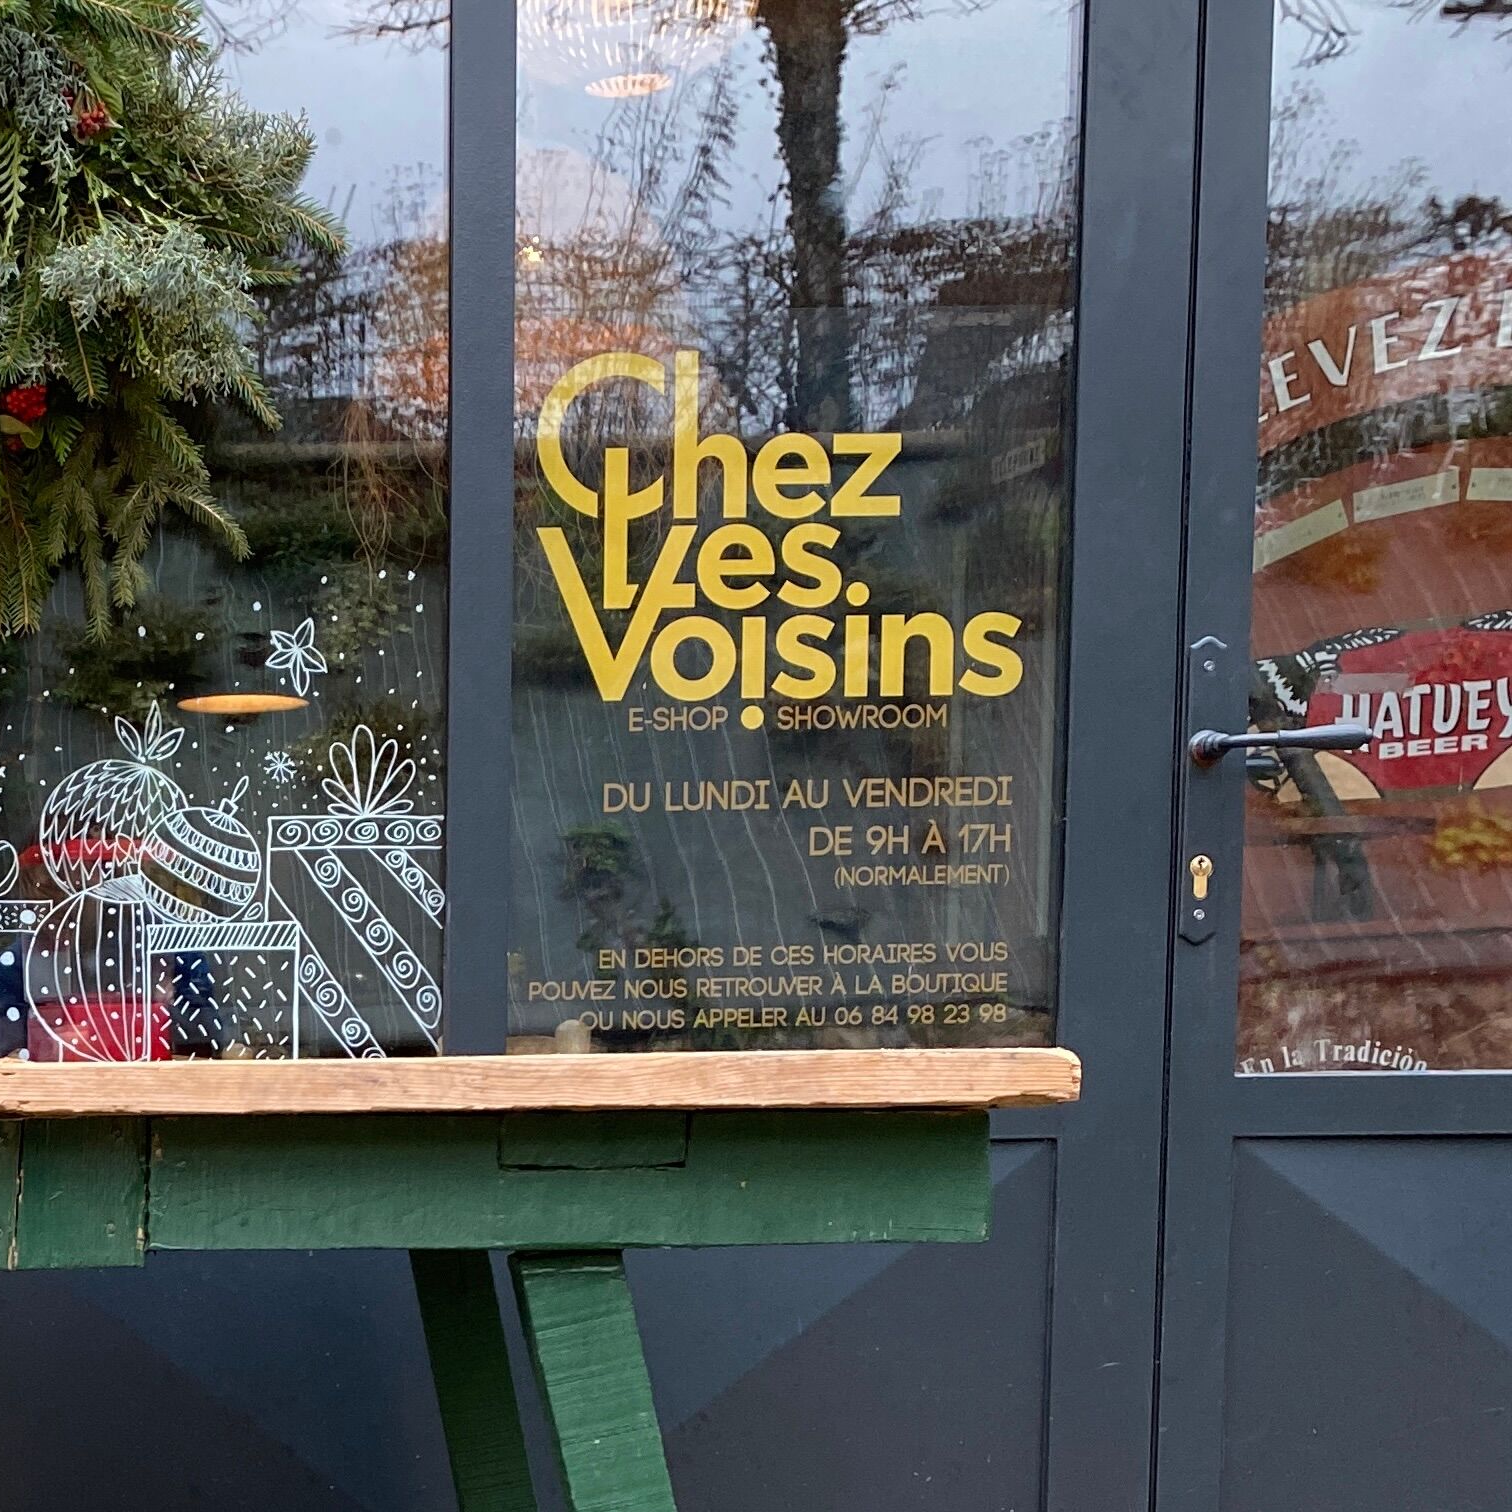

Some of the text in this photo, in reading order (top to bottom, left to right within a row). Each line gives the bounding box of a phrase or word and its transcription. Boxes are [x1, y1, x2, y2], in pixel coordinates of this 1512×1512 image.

[1258, 295, 1464, 423] EVEZ
[536, 349, 903, 519] Chez
[536, 525, 1024, 702] Voisins
[628, 703, 947, 732] E-SHOP SHOWROOM
[1378, 733, 1489, 760] BEER
[603, 775, 1013, 813] DU LUNDI AU VENDREDI
[809, 819, 1011, 856] DE 9H À 17H
[834, 863, 1010, 888] (NORMALEMENT)
[599, 941, 1009, 969] EN DEHORS DE CES HORAIRES VOUS
[528, 971, 1008, 1001] POUVEZ NOUS RETROUVER À LA BOUTIQUE
[579, 1002, 1007, 1031] OU NOUS APPELER AU 06 84 98 23 98
[1240, 1057, 1275, 1074] En
[1281, 1045, 1304, 1069] la
